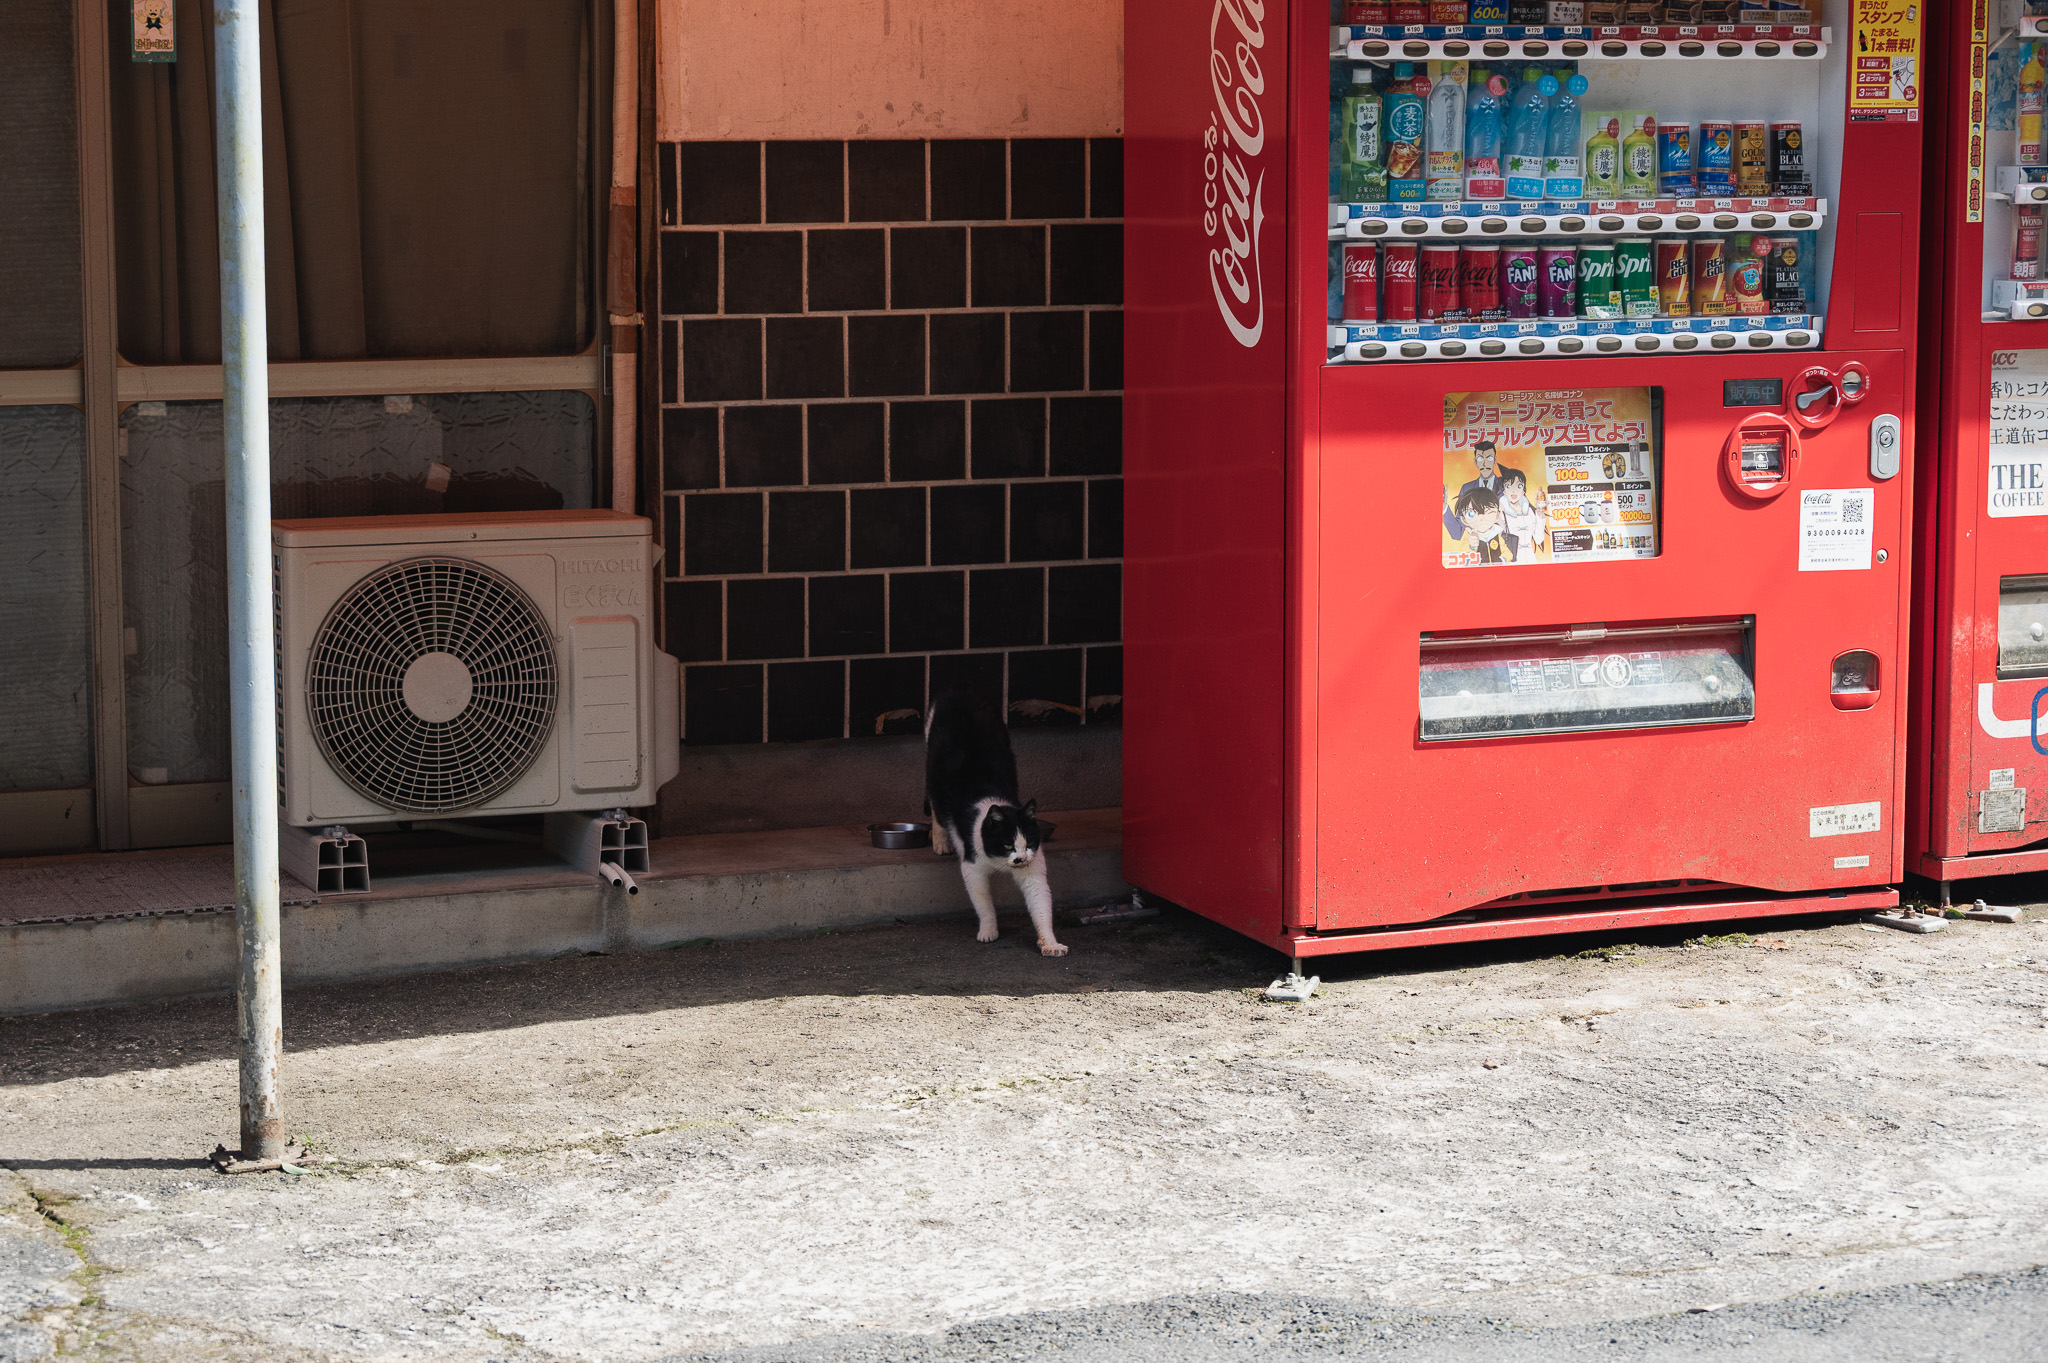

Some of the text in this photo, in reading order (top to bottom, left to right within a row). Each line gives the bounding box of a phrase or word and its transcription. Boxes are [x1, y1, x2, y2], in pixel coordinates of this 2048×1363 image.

[1473, 7, 1507, 20] 600ml
[1859, 1, 1888, 10] 買うたび
[1859, 11, 1905, 24] スタンプ
[1871, 28, 1899, 37] たまると
[1972, 46, 1984, 79] お買得
[1859, 74, 1865, 82] 2
[1972, 90, 1982, 123] お買得
[1404, 106, 1417, 136] 麦茶
[1360, 132, 1371, 159] 綾鷹
[1970, 135, 1982, 167] お買得
[1599, 149, 1610, 172] 綾鷹
[1636, 147, 1647, 170] 綾鷹
[1515, 184, 1539, 193] 天然水
[1553, 184, 1577, 193] 天然水
[1969, 178, 1980, 211] お買得
[1500, 392, 1534, 402] ジョージア
[1544, 390, 1583, 399] 名探偵コナン
[1730, 384, 1775, 400] 販売中
[1467, 400, 1613, 424] ジョージアを買って
[1990, 404, 2048, 421] こだわっ
[1992, 463, 2044, 490] THE
[1618, 495, 1633, 504] 500
[1993, 491, 2044, 508] COFFEE
[563, 558, 641, 574] HITACHI
[1448, 552, 1480, 565] コナン
